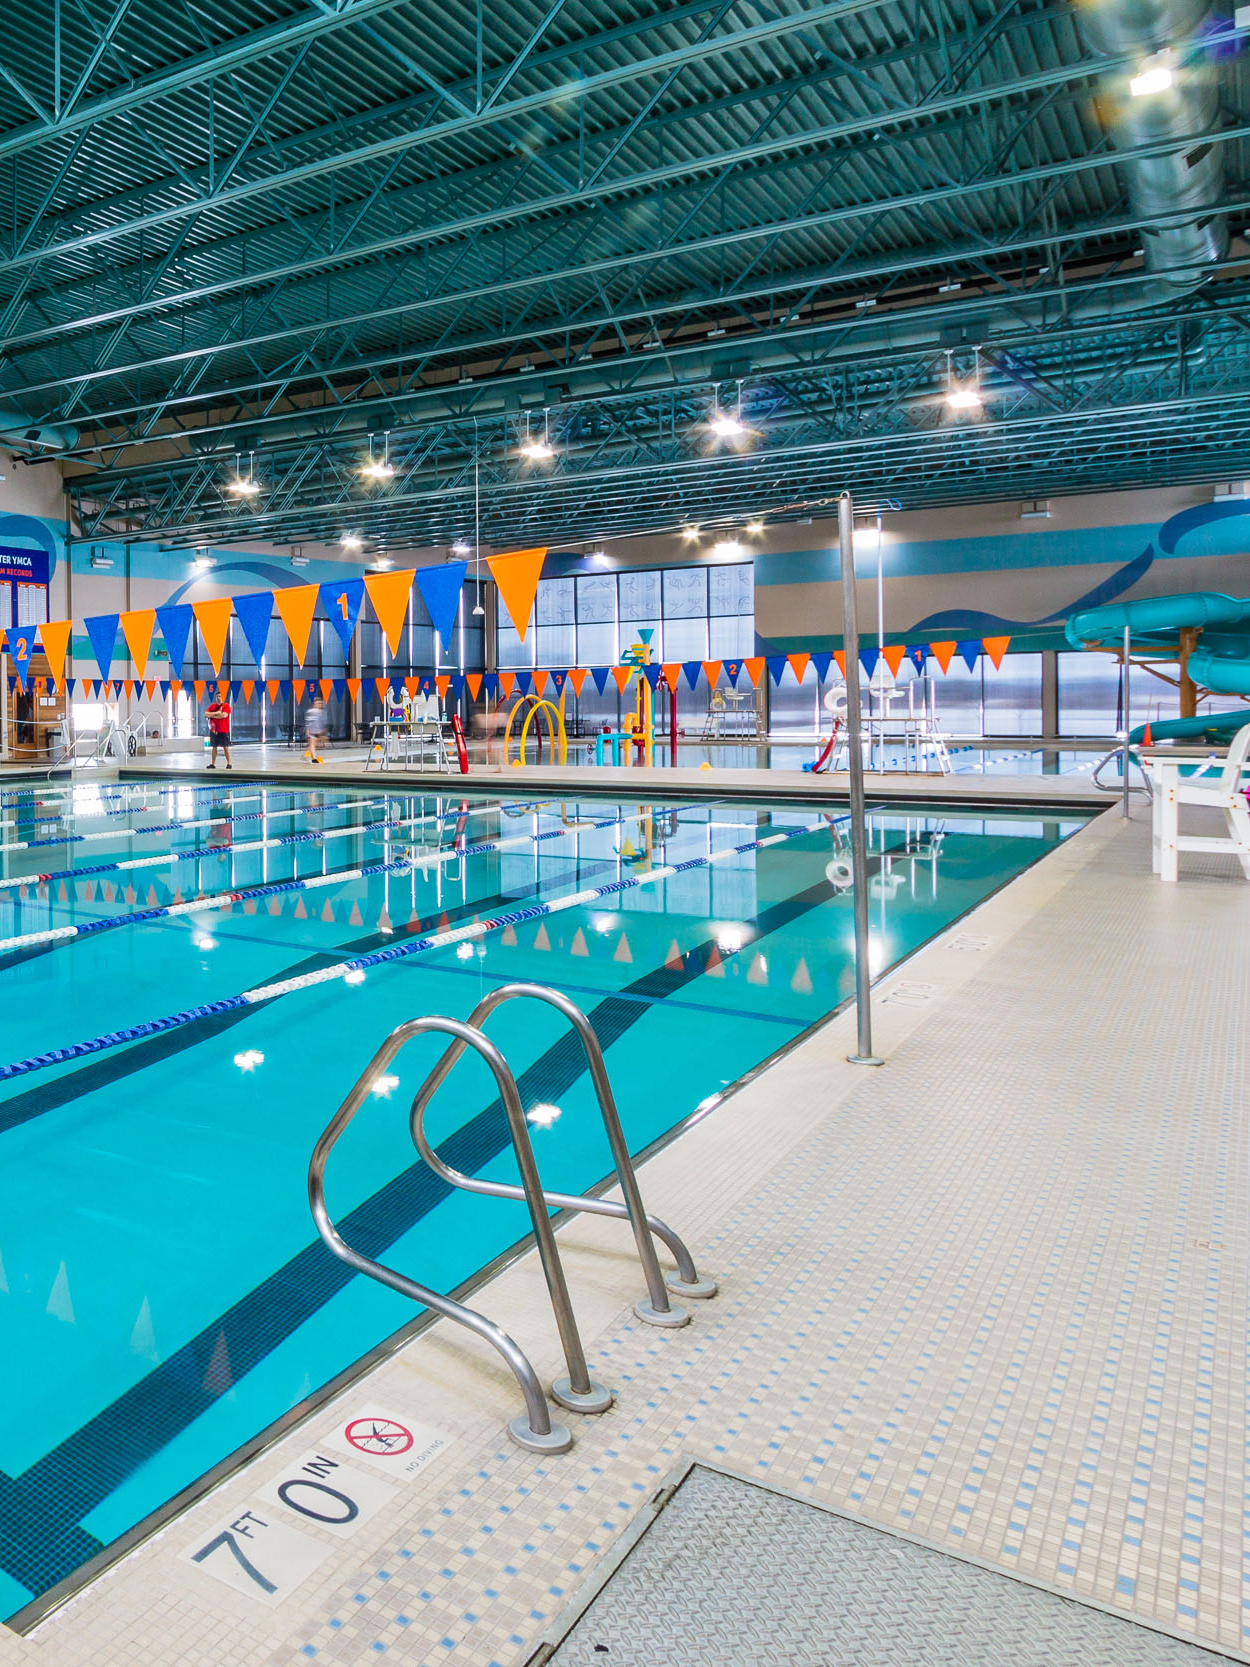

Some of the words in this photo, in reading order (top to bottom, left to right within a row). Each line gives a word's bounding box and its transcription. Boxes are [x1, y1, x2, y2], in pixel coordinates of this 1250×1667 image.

[12, 556, 32, 567] YMCA
[6, 568, 33, 578] RECORDS
[336, 592, 349, 621] 1
[16, 637, 28, 661] 2
[914, 650, 921, 662] 1
[729, 663, 737, 675] 2
[423, 681, 430, 690] 4
[556, 674, 563, 686] 3
[405, 1461, 419, 1472] NO
[417, 1439, 444, 1461] DIVING
